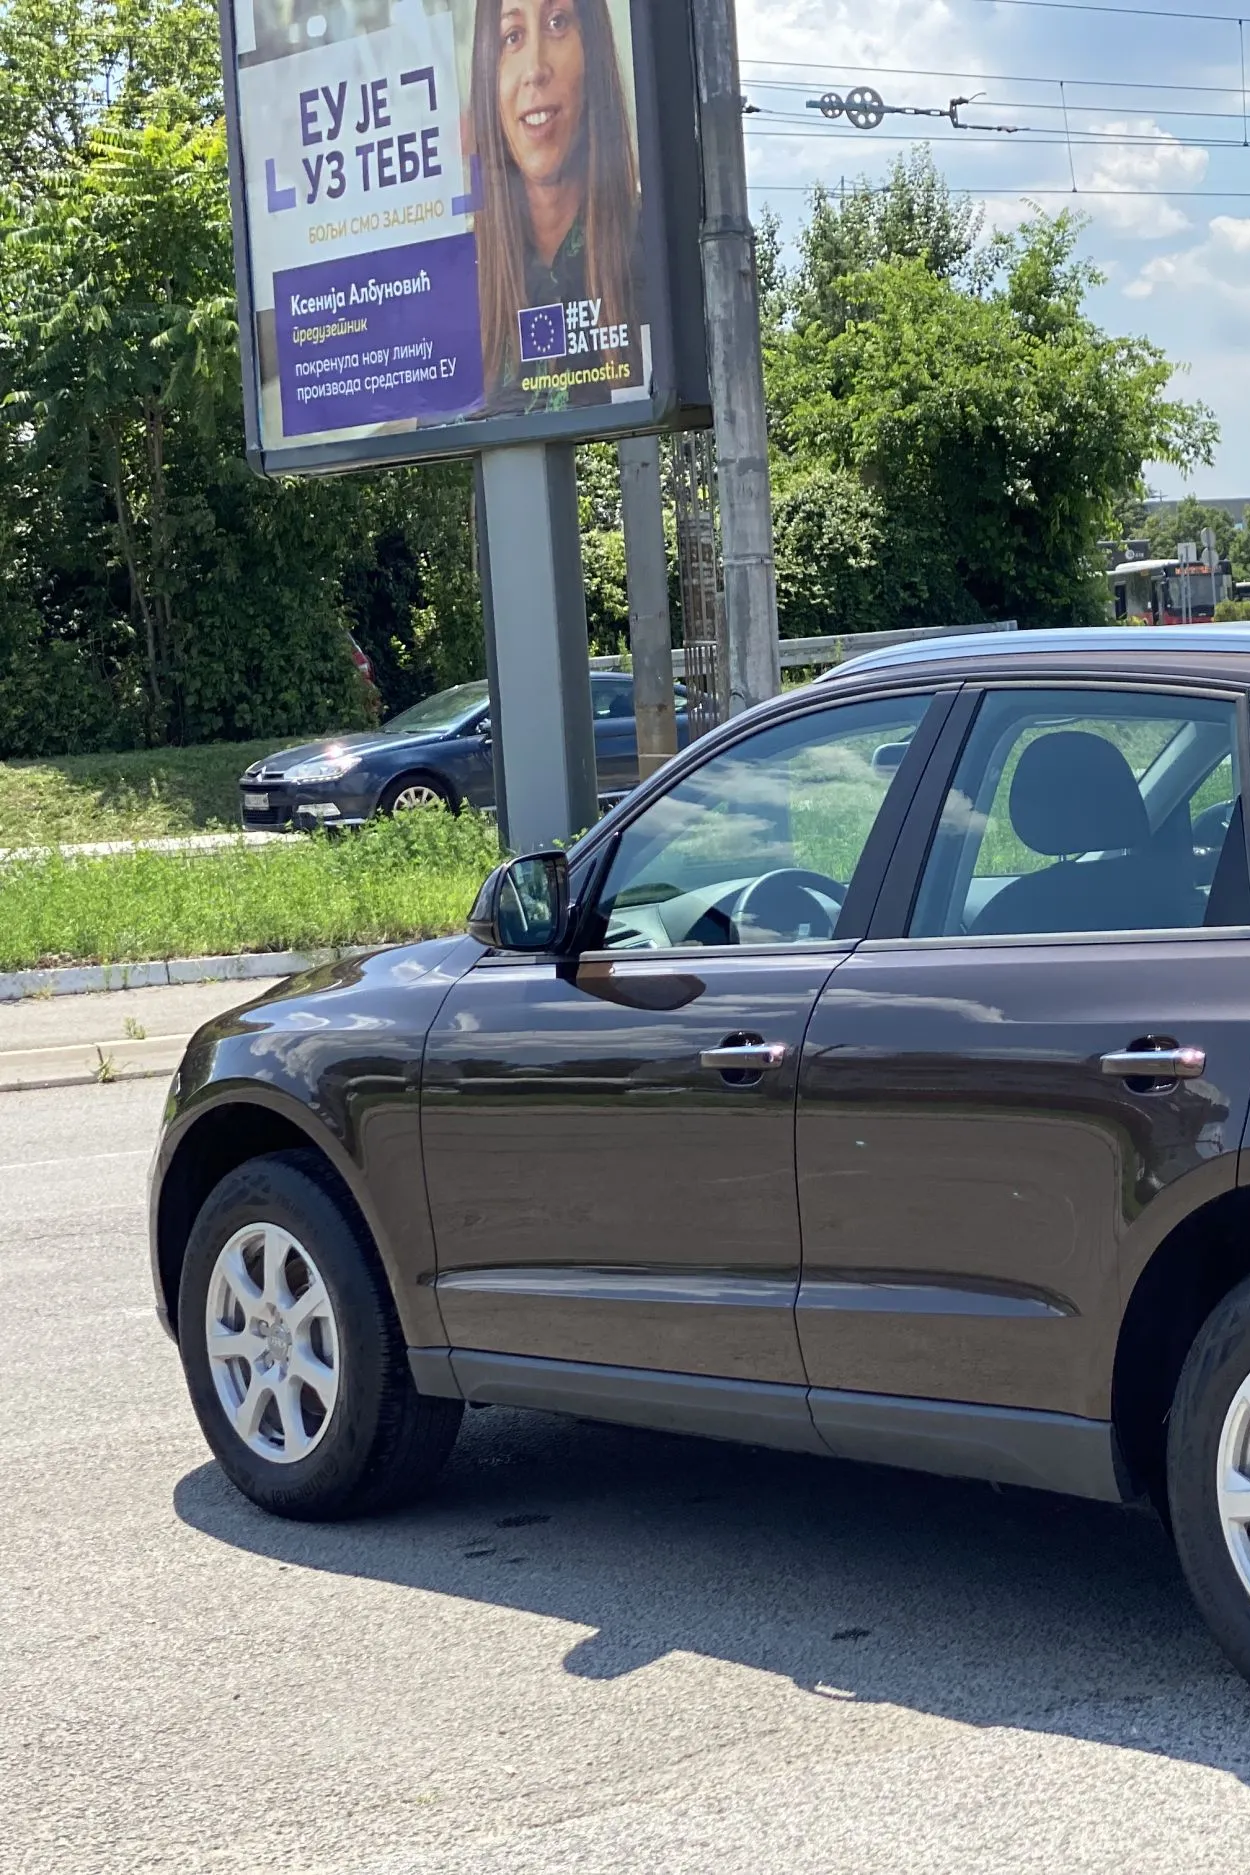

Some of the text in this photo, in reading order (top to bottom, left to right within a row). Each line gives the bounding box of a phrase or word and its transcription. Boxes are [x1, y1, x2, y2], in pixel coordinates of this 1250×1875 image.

[300, 78, 391, 146] ЕУ ЈЕ
[302, 126, 442, 204] УЗ ТЕБЕ
[309, 199, 445, 245] БОЉИ СМО ЗАЈЕДНО
[291, 269, 431, 317] Ксенија Албуновић
[566, 298, 602, 331] #ЕУ
[295, 337, 433, 378] покренула нову линију
[568, 323, 629, 355] ЗА ТЕБЕ
[297, 357, 457, 404] производа средствима ЕУ
[521, 360, 631, 392] eumogucnosti.rs
